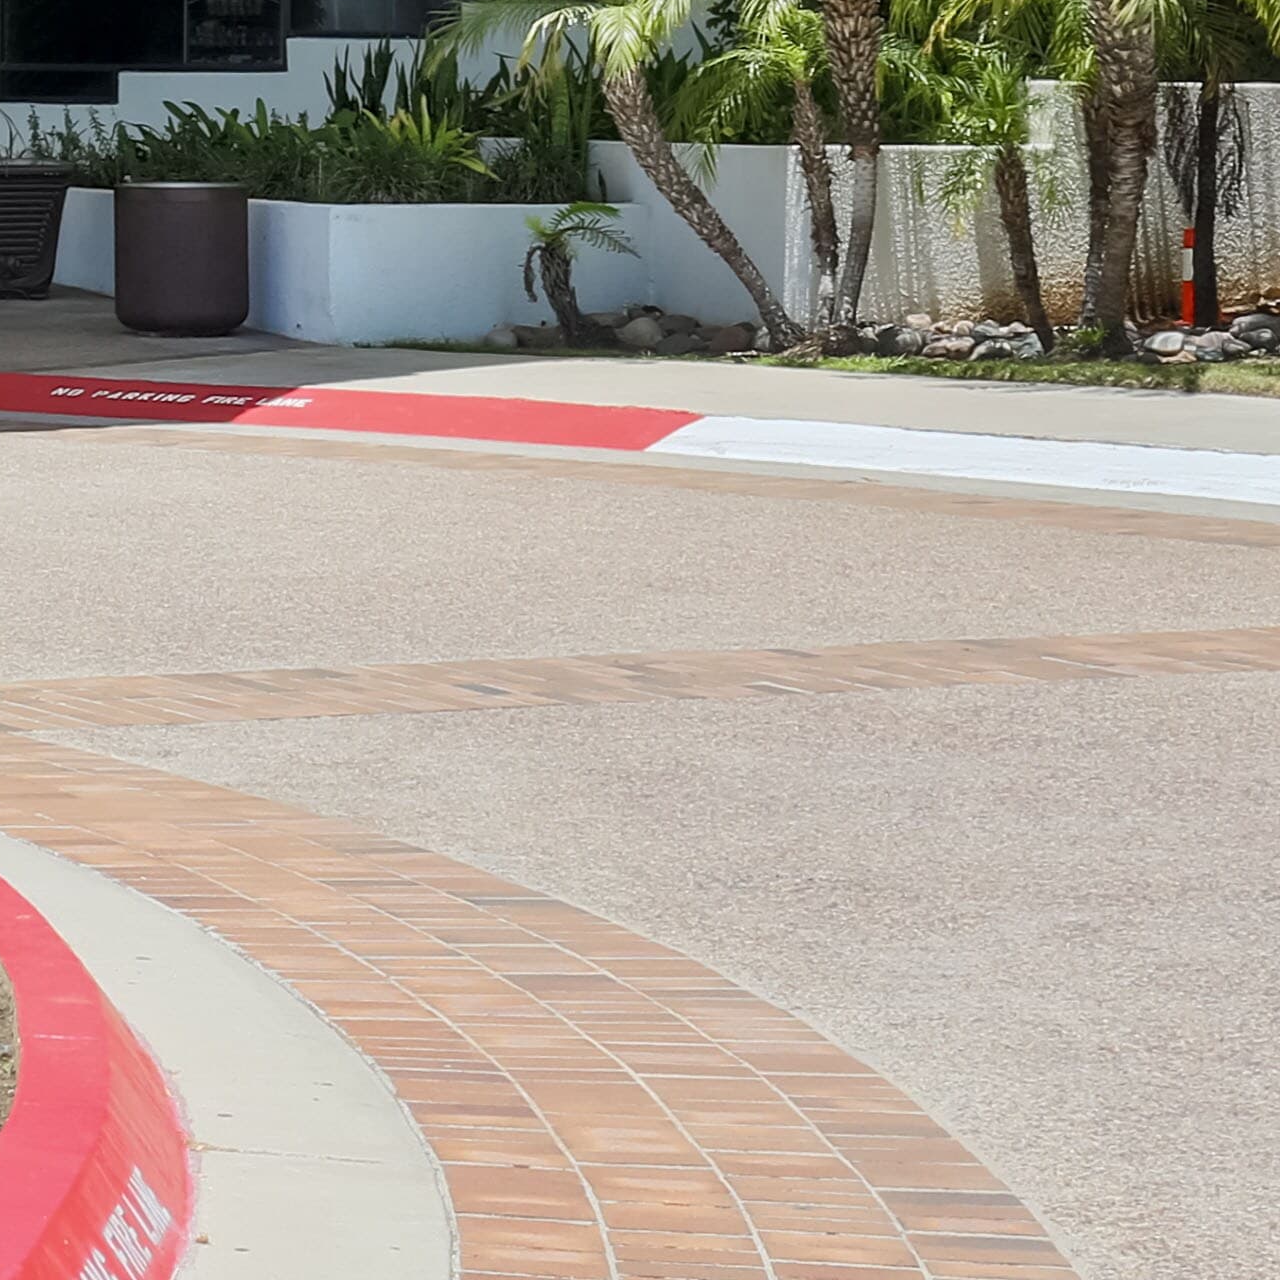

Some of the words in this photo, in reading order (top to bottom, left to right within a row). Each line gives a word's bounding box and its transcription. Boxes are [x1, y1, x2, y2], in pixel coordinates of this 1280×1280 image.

[50, 386, 85, 397] NO
[90, 388, 196, 404] PARKING
[201, 395, 254, 407] FIRE
[255, 396, 313, 409] LANE
